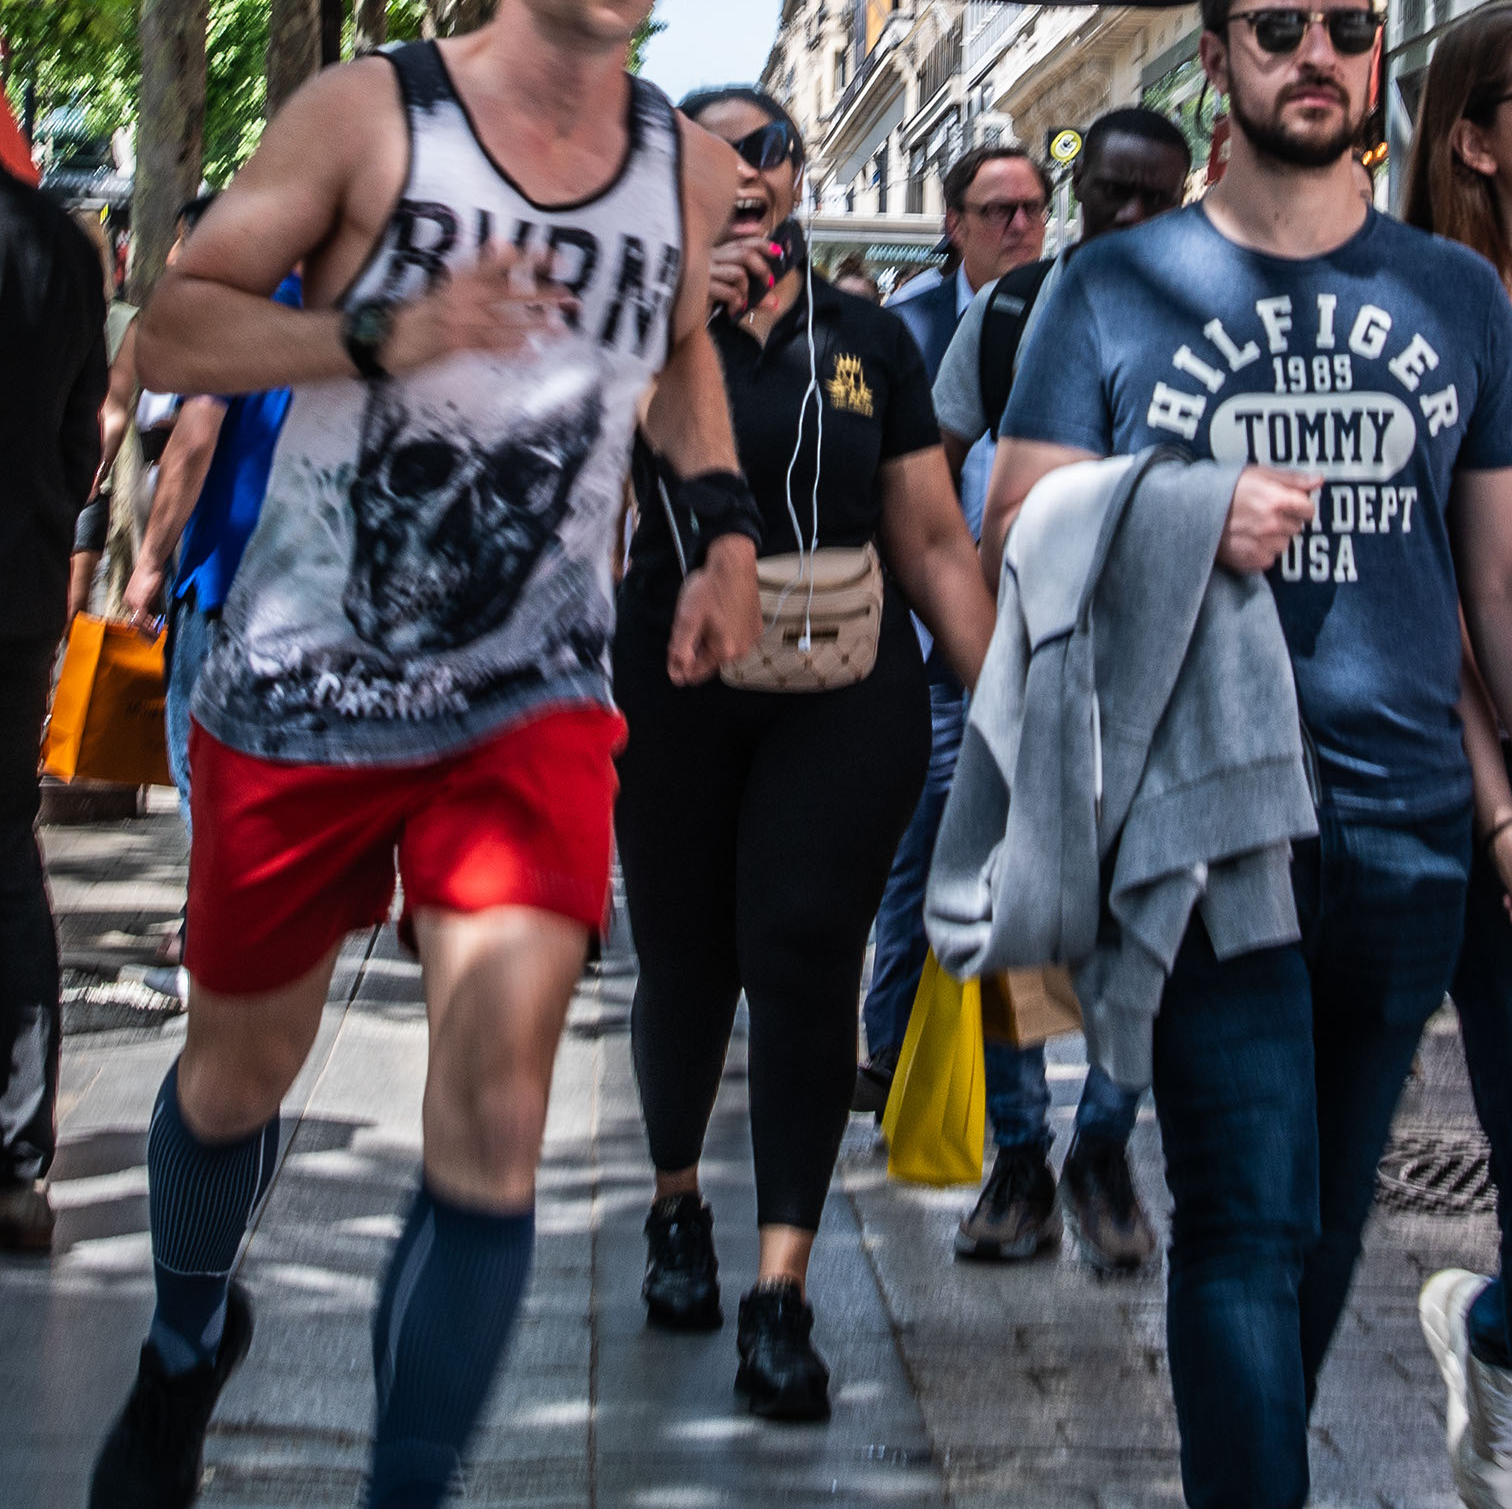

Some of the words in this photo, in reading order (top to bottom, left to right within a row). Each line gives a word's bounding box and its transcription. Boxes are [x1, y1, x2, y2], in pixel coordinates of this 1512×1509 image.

[1147, 292, 1459, 440] HILFIGER
[1273, 354, 1353, 393] 1985
[1235, 409, 1394, 467] TOMMY
[1331, 486, 1418, 533] DEPT
[1281, 534, 1359, 583] USA
